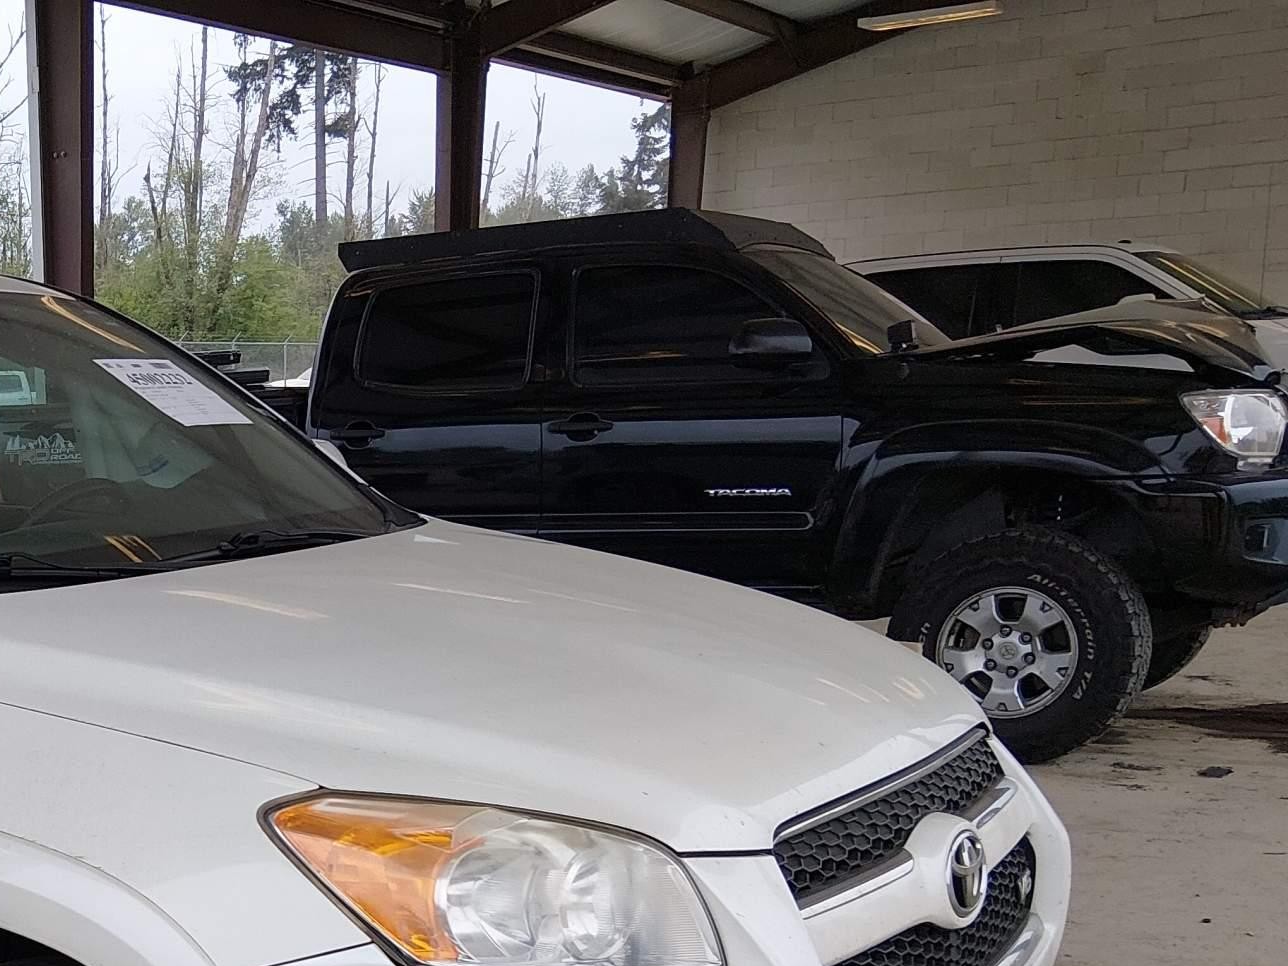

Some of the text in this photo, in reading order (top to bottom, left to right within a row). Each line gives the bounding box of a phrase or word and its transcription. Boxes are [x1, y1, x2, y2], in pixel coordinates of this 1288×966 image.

[126, 372, 193, 386] 45002232
[704, 487, 792, 497] TACOMA
[1072, 671, 1094, 700] T/A
